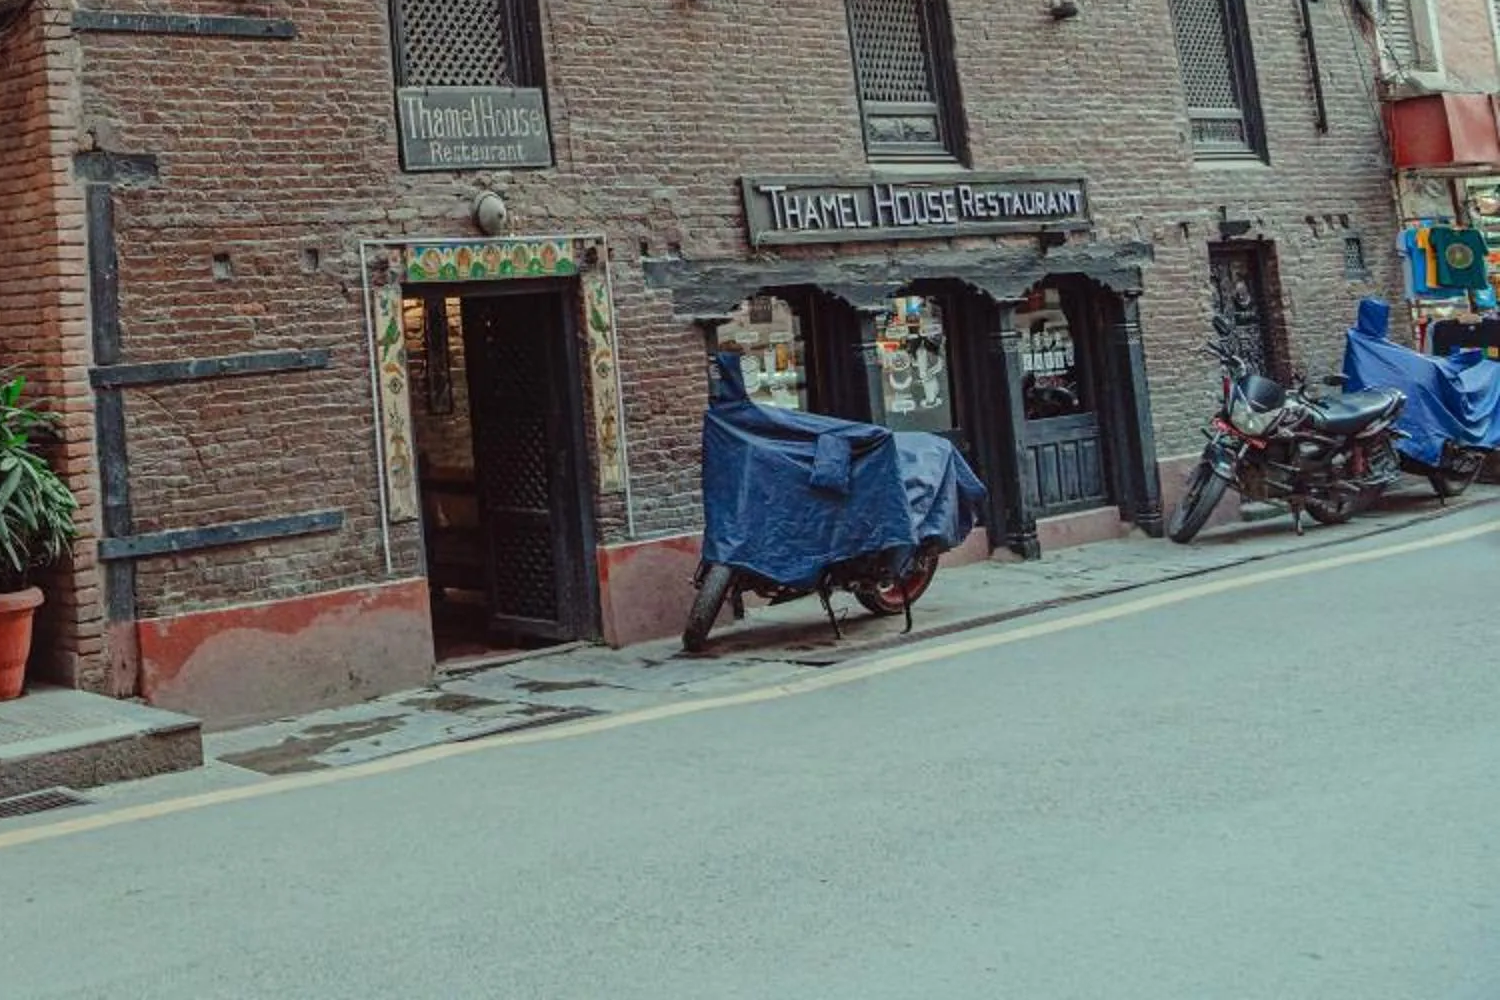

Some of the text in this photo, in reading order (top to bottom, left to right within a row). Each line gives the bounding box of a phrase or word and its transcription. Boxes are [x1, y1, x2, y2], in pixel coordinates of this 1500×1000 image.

[403, 95, 543, 139] Thamel House
[429, 140, 525, 164] Restaurant
[759, 183, 1082, 230] THAMEL HOUSE RESTAURANT
